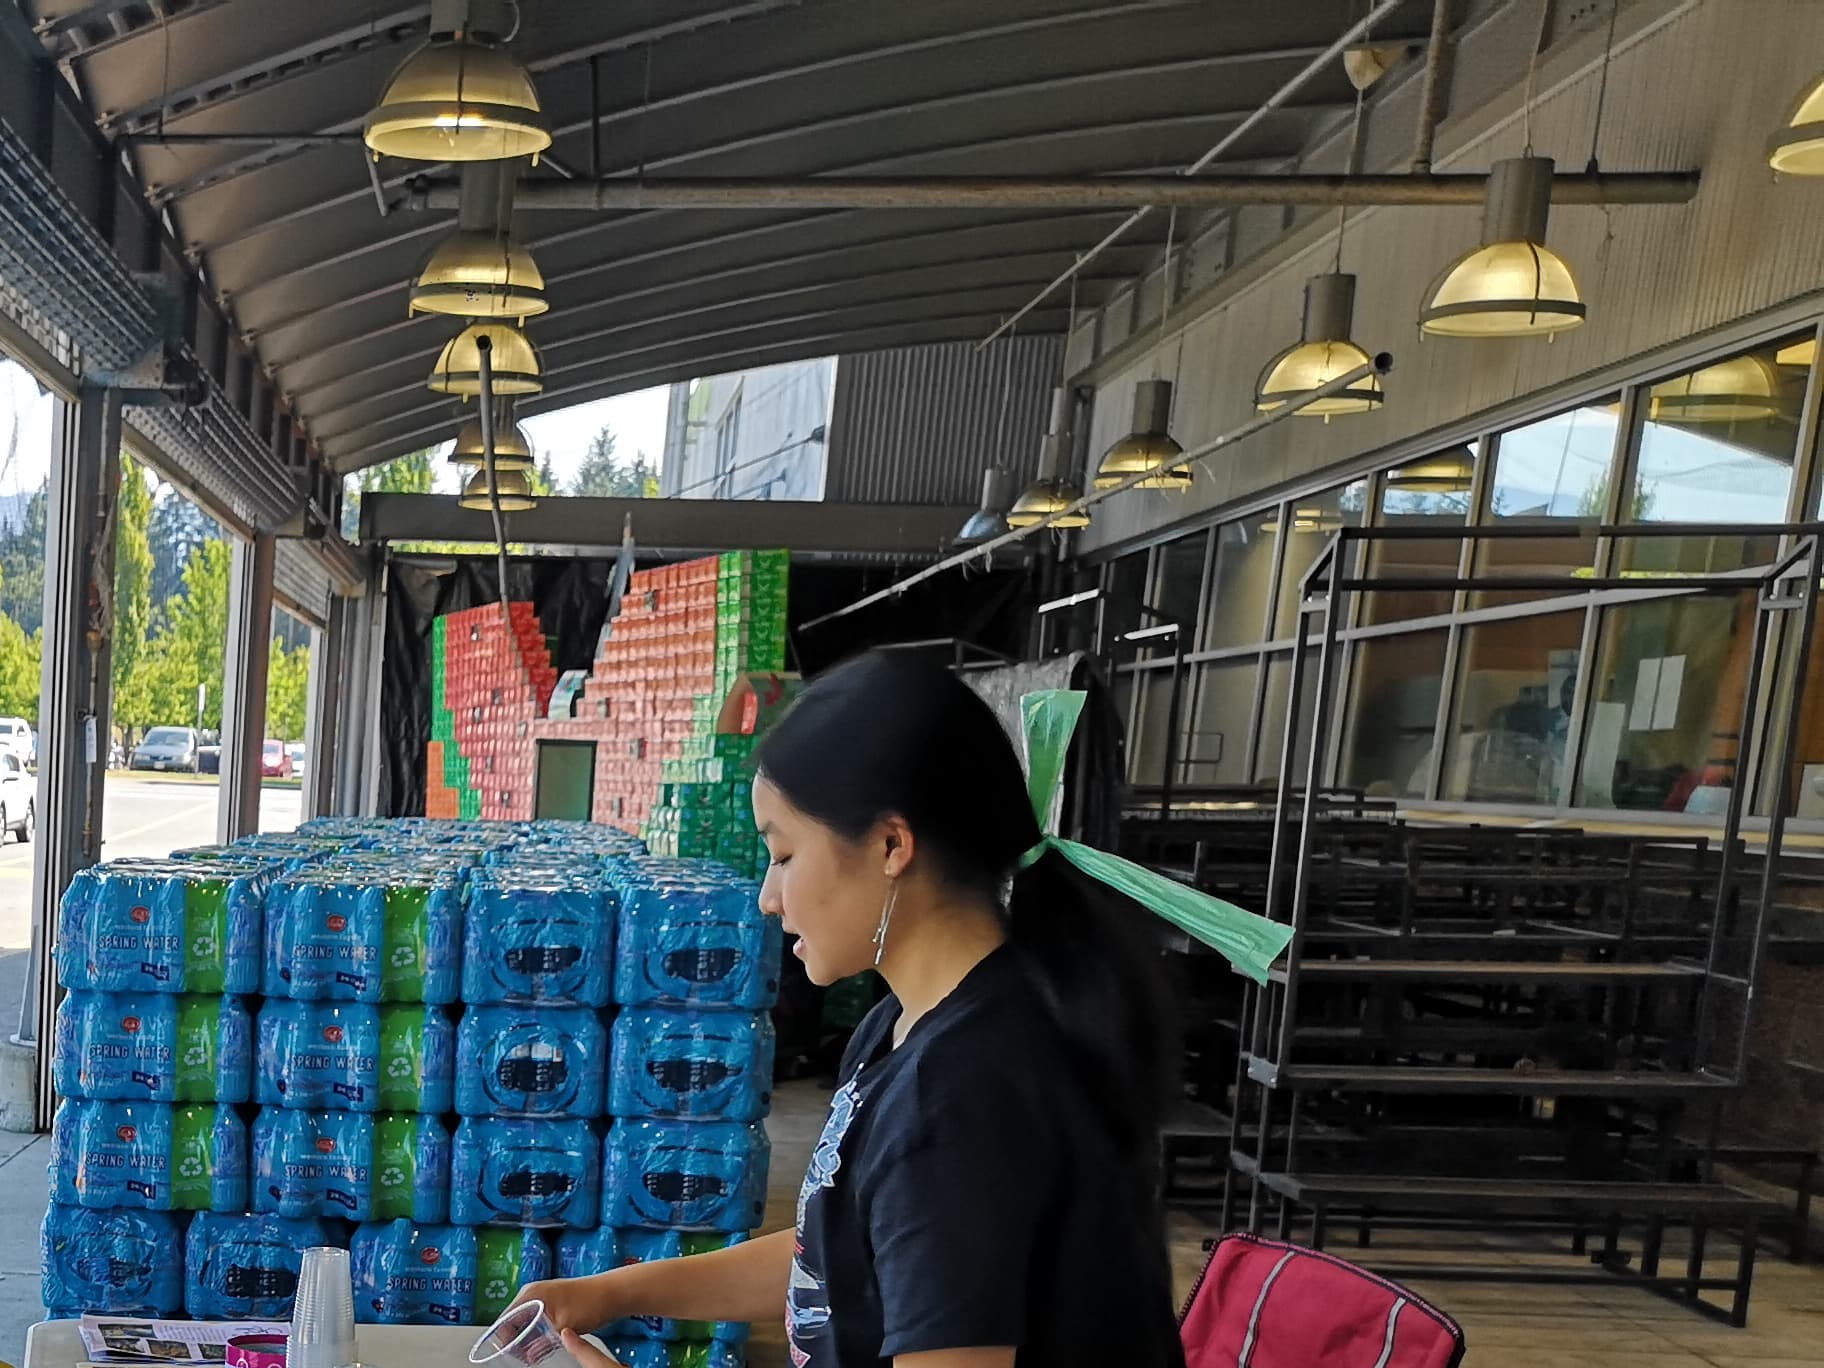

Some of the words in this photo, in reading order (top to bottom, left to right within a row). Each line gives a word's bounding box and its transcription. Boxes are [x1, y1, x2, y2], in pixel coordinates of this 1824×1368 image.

[98, 936, 137, 950] SPRING
[143, 936, 179, 950] WATER
[294, 944, 333, 959] SPRING
[90, 1044, 128, 1058] SPRING
[135, 1045, 171, 1059] WATER
[291, 1055, 330, 1070] SPRING
[335, 1056, 374, 1071] WATER
[86, 1153, 124, 1167] SPRING
[129, 1155, 167, 1169] WATER
[284, 1164, 323, 1178] SPRING
[387, 1276, 426, 1291] SPRING
[432, 1278, 473, 1292] WATER
